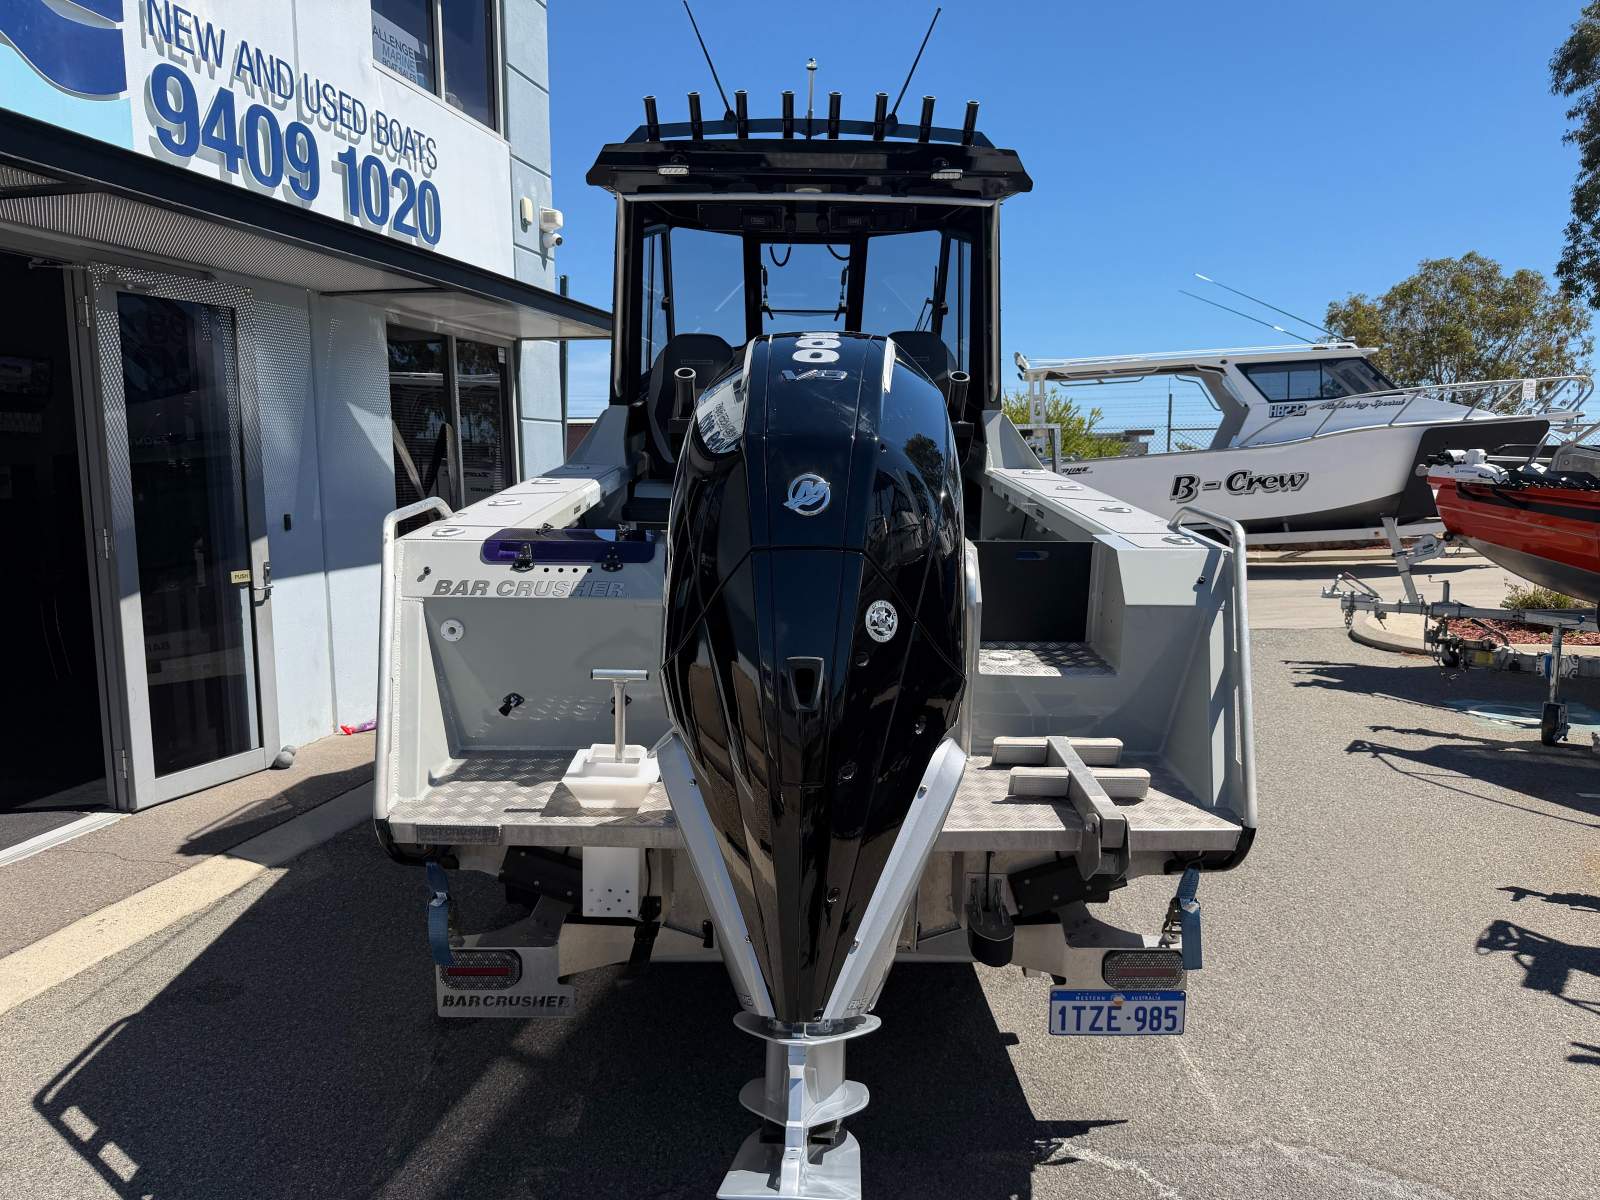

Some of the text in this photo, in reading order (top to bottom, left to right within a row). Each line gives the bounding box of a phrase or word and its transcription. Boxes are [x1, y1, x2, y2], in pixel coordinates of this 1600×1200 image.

[147, 0, 437, 170] NEW AND USED BOATS
[151, 61, 441, 246] 9409 1020
[432, 579, 625, 598] BAR CRUSHER
